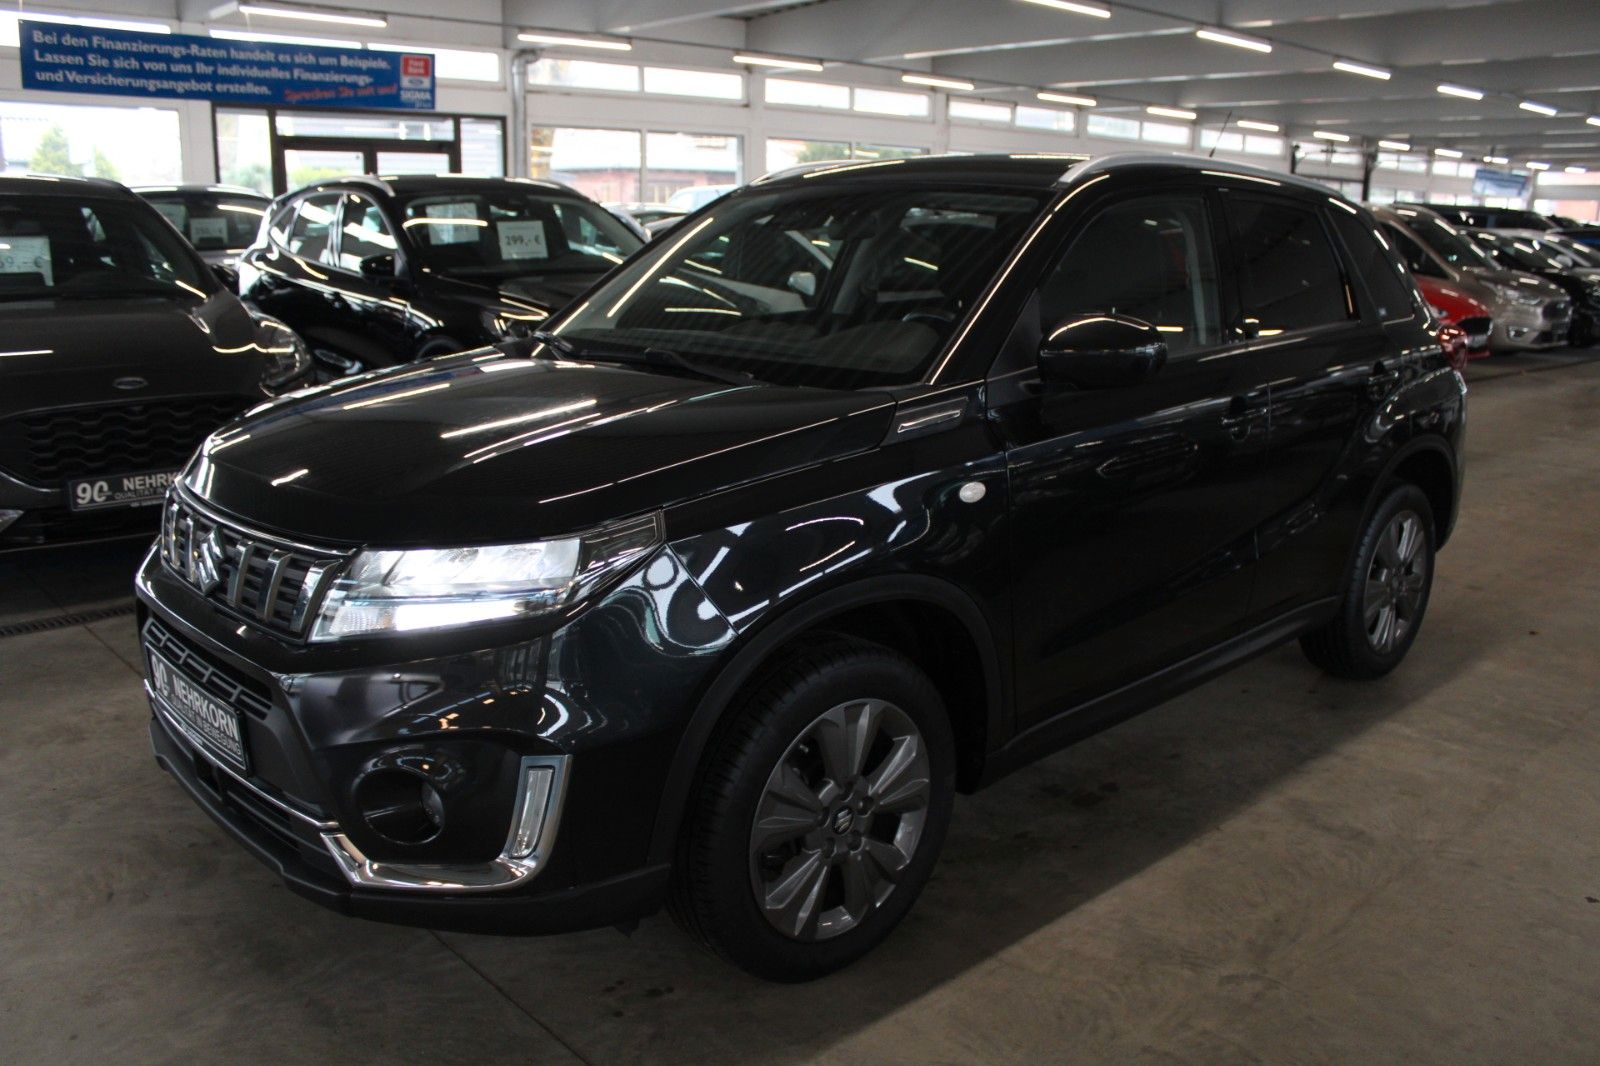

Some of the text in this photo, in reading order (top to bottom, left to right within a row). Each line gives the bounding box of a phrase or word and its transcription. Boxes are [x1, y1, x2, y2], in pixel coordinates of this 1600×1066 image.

[33, 30, 57, 45] Bei
[62, 33, 88, 48] den
[92, 36, 227, 59] Finanzierungs-Raten
[230, 48, 275, 62] handelt
[278, 54, 291, 64] es
[294, 53, 315, 65] sich
[318, 56, 338, 66] um
[34, 50, 374, 86] Lassen Sie sich von uns Ihr individuelles Finanzierungs-
[36, 70, 272, 96] und Versicherungsangebot erstellen.
[76, 481, 109, 505] 90
[172, 674, 240, 742] NEHRKORN
